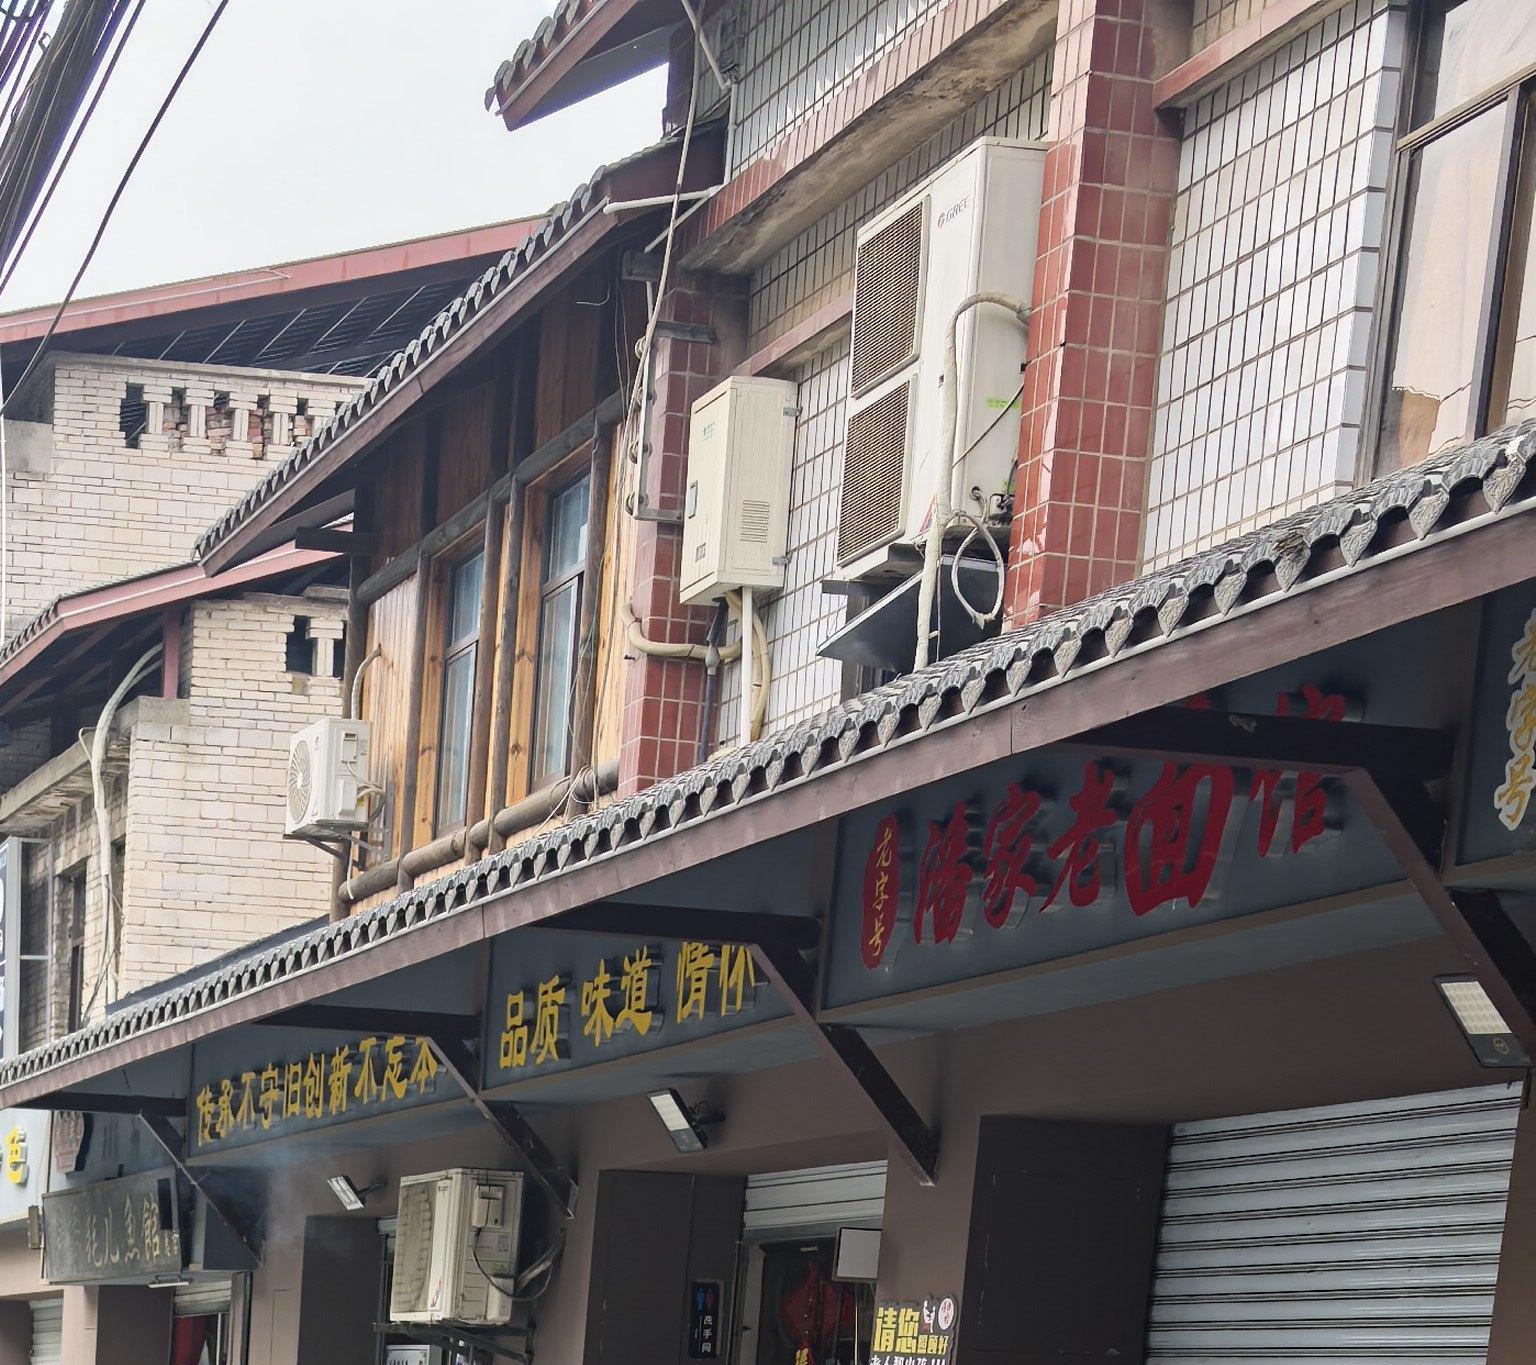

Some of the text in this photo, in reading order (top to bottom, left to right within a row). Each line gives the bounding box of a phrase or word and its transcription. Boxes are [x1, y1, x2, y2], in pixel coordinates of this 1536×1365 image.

[867, 825, 893, 958] 老字号
[499, 941, 755, 1069] 品质 味道 情怀
[874, 1306, 949, 1355] 请您照顾好
